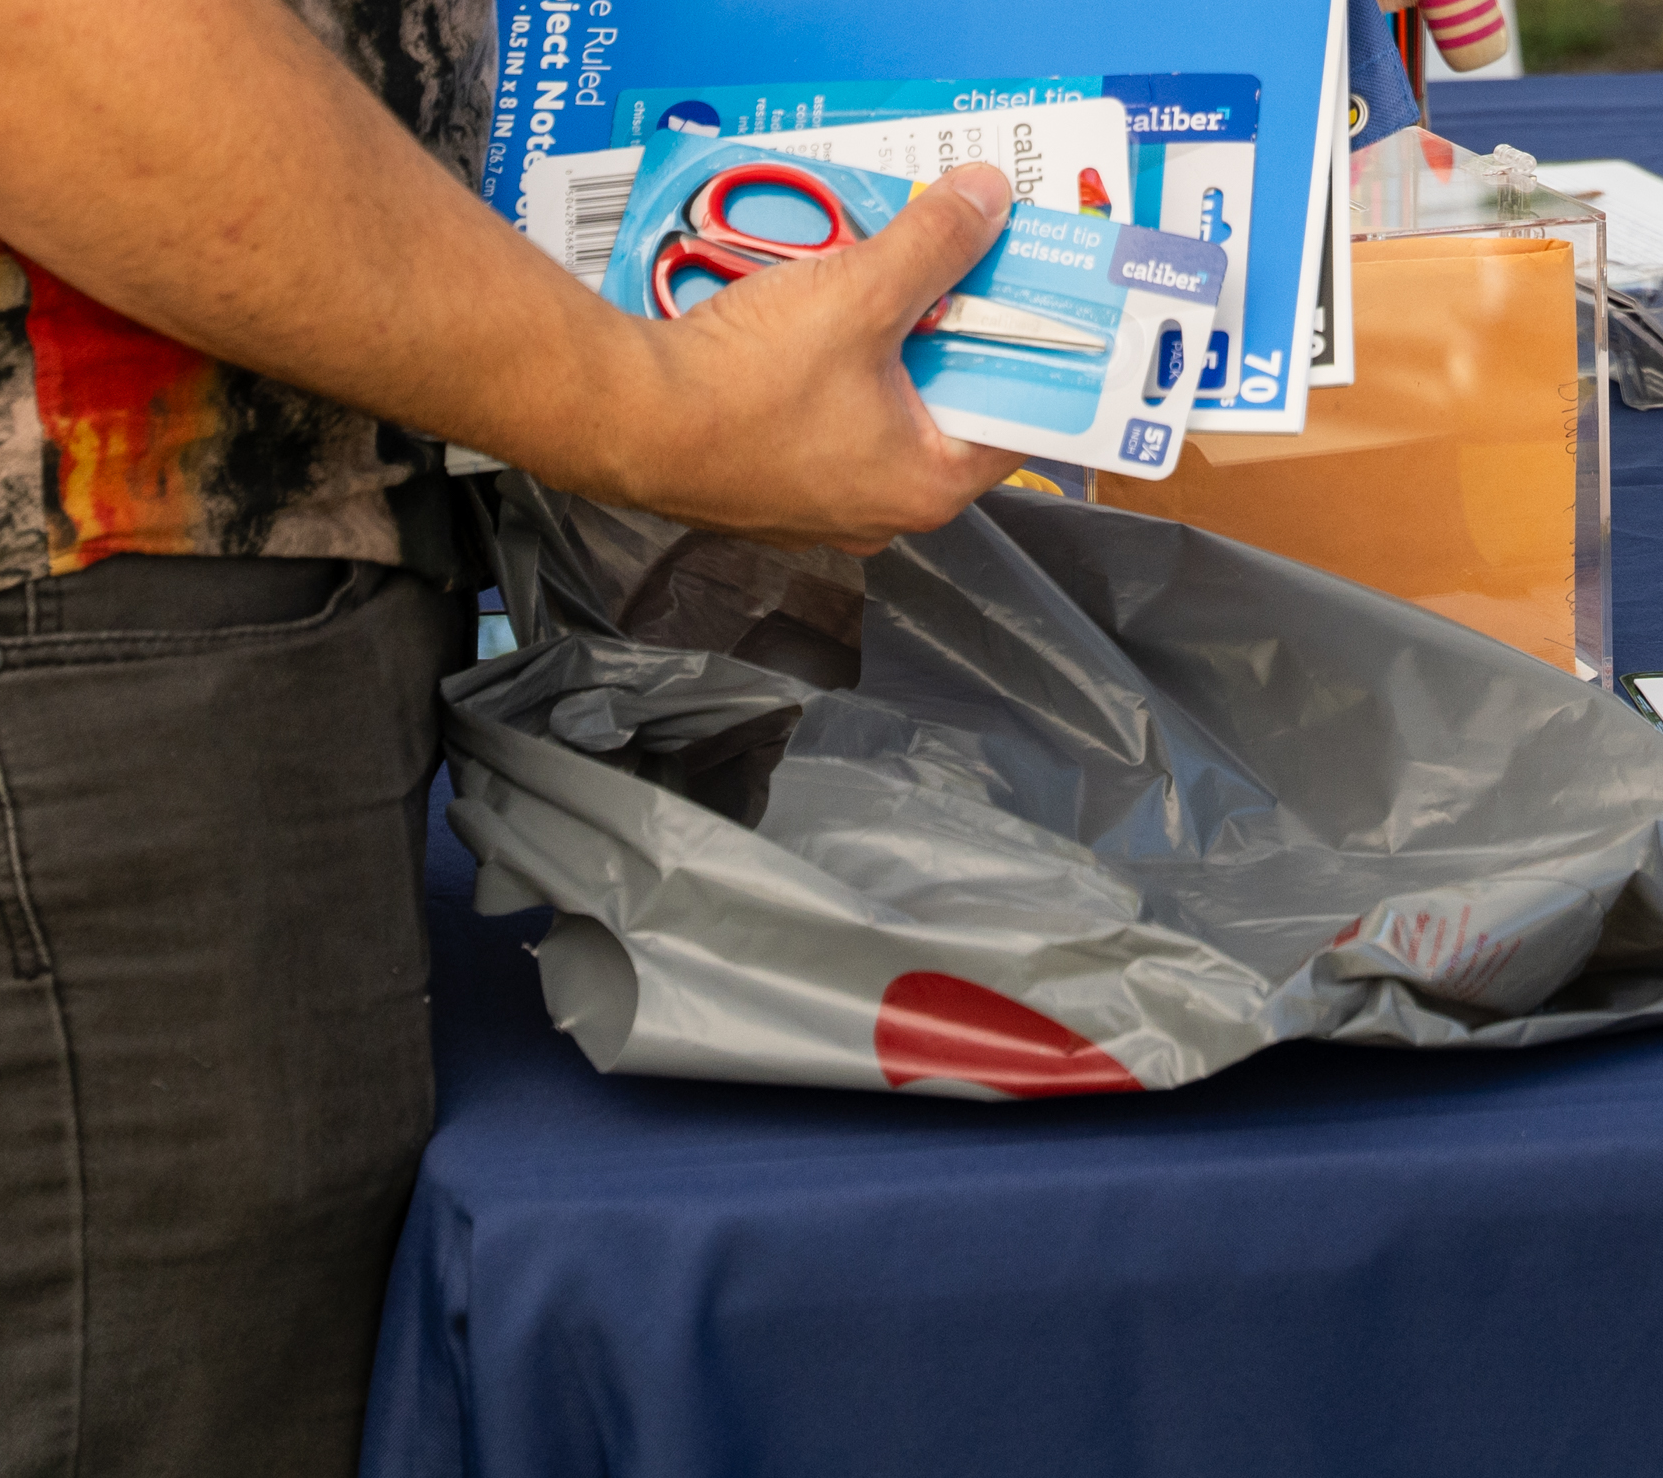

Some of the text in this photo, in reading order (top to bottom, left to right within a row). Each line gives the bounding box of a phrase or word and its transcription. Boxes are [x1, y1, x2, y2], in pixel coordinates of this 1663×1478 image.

[508, 15, 532, 49] 10.5
[504, 51, 527, 76] IN
[575, 27, 618, 107] Ruled
[500, 81, 518, 94] x
[953, 86, 1084, 111] chisel tip
[498, 97, 519, 110] 8
[631, 100, 646, 137] chisel
[493, 113, 515, 139] IN
[1125, 105, 1224, 133] caliber
[1013, 123, 1044, 206] calibe
[1073, 225, 1102, 249] tip
[1008, 238, 1096, 270] scissors
[1122, 260, 1201, 292] caliber
[1169, 340, 1184, 381] PACK
[1240, 350, 1283, 404] 70
[1126, 427, 1139, 456] INCH
